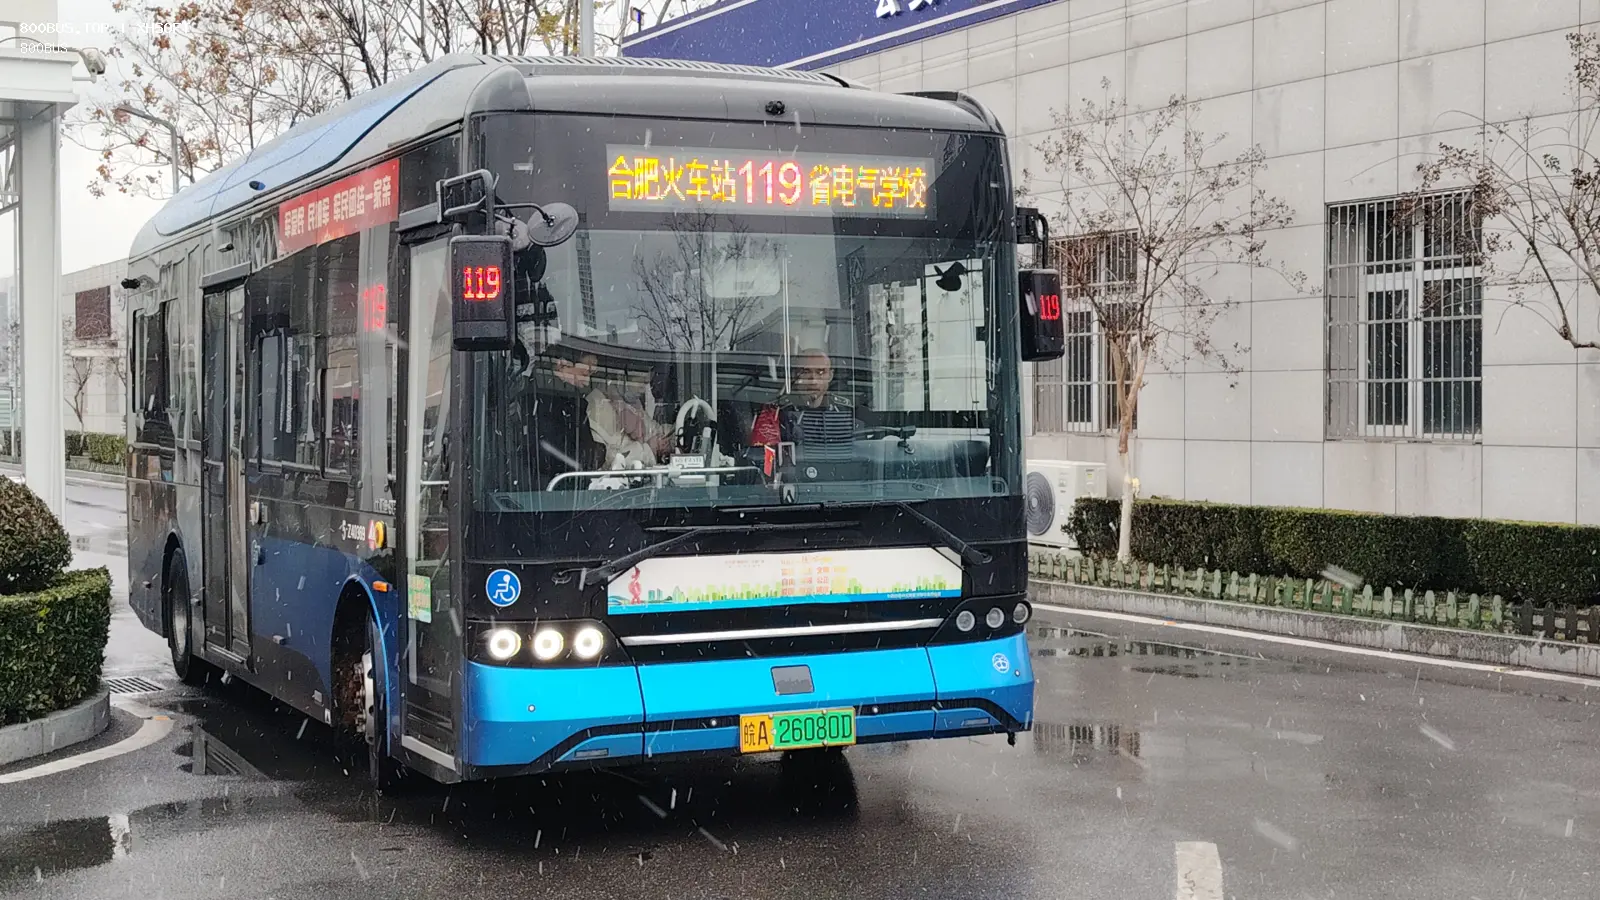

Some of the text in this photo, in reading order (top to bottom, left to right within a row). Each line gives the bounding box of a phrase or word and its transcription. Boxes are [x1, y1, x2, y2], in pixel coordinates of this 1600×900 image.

[608, 155, 927, 209] 合肥火车站 119 省电气学校
[463, 265, 501, 300] 119
[1039, 294, 1061, 321] 119
[743, 714, 853, 747] 皖A 26080D
